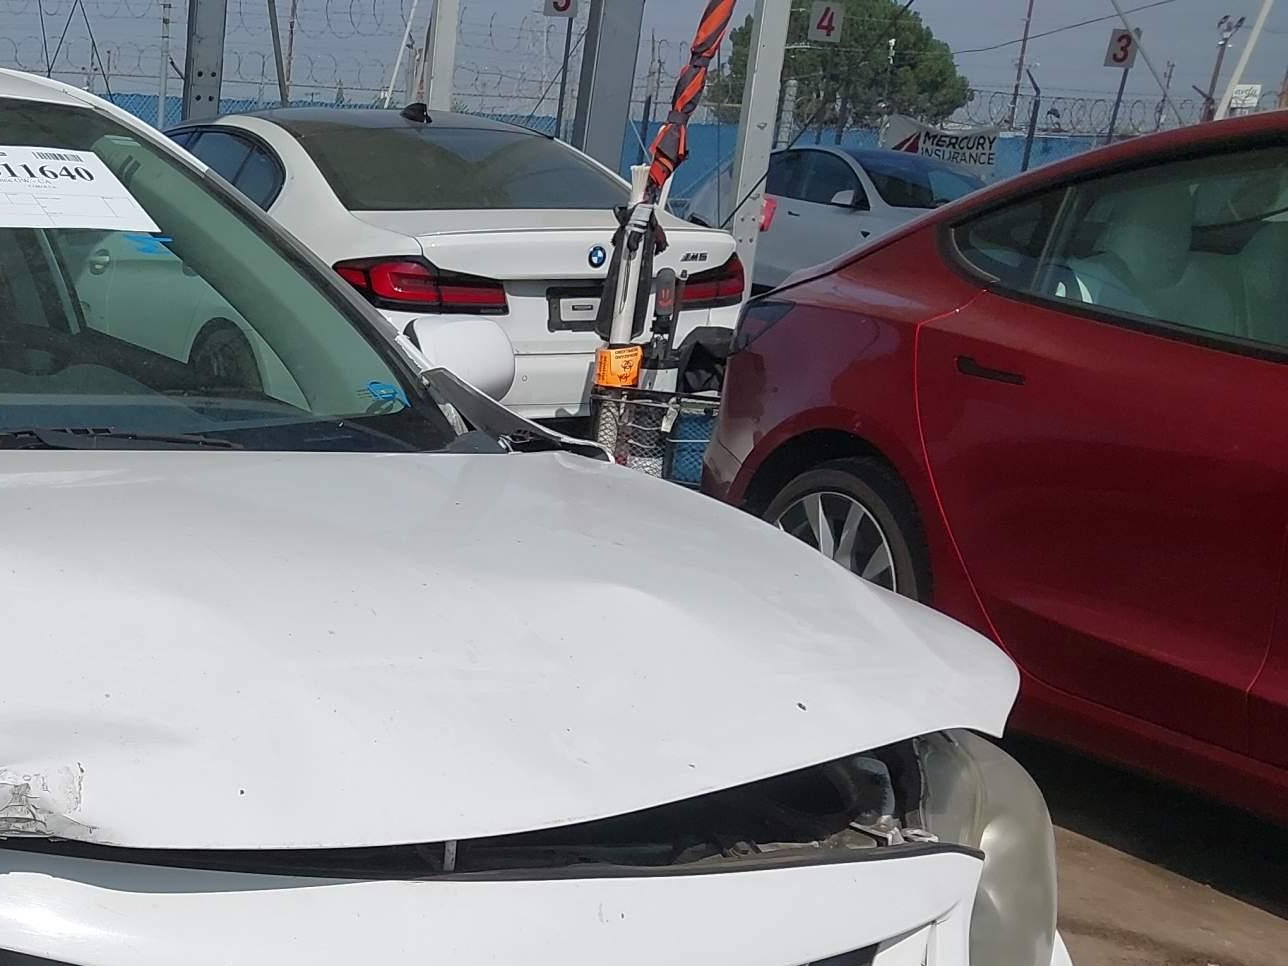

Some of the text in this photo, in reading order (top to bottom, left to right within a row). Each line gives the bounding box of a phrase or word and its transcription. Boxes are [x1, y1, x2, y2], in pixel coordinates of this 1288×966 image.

[815, 7, 835, 36] 4
[1112, 34, 1131, 63] 3
[923, 130, 997, 151] MERCURY
[921, 146, 995, 166] INSURANCE
